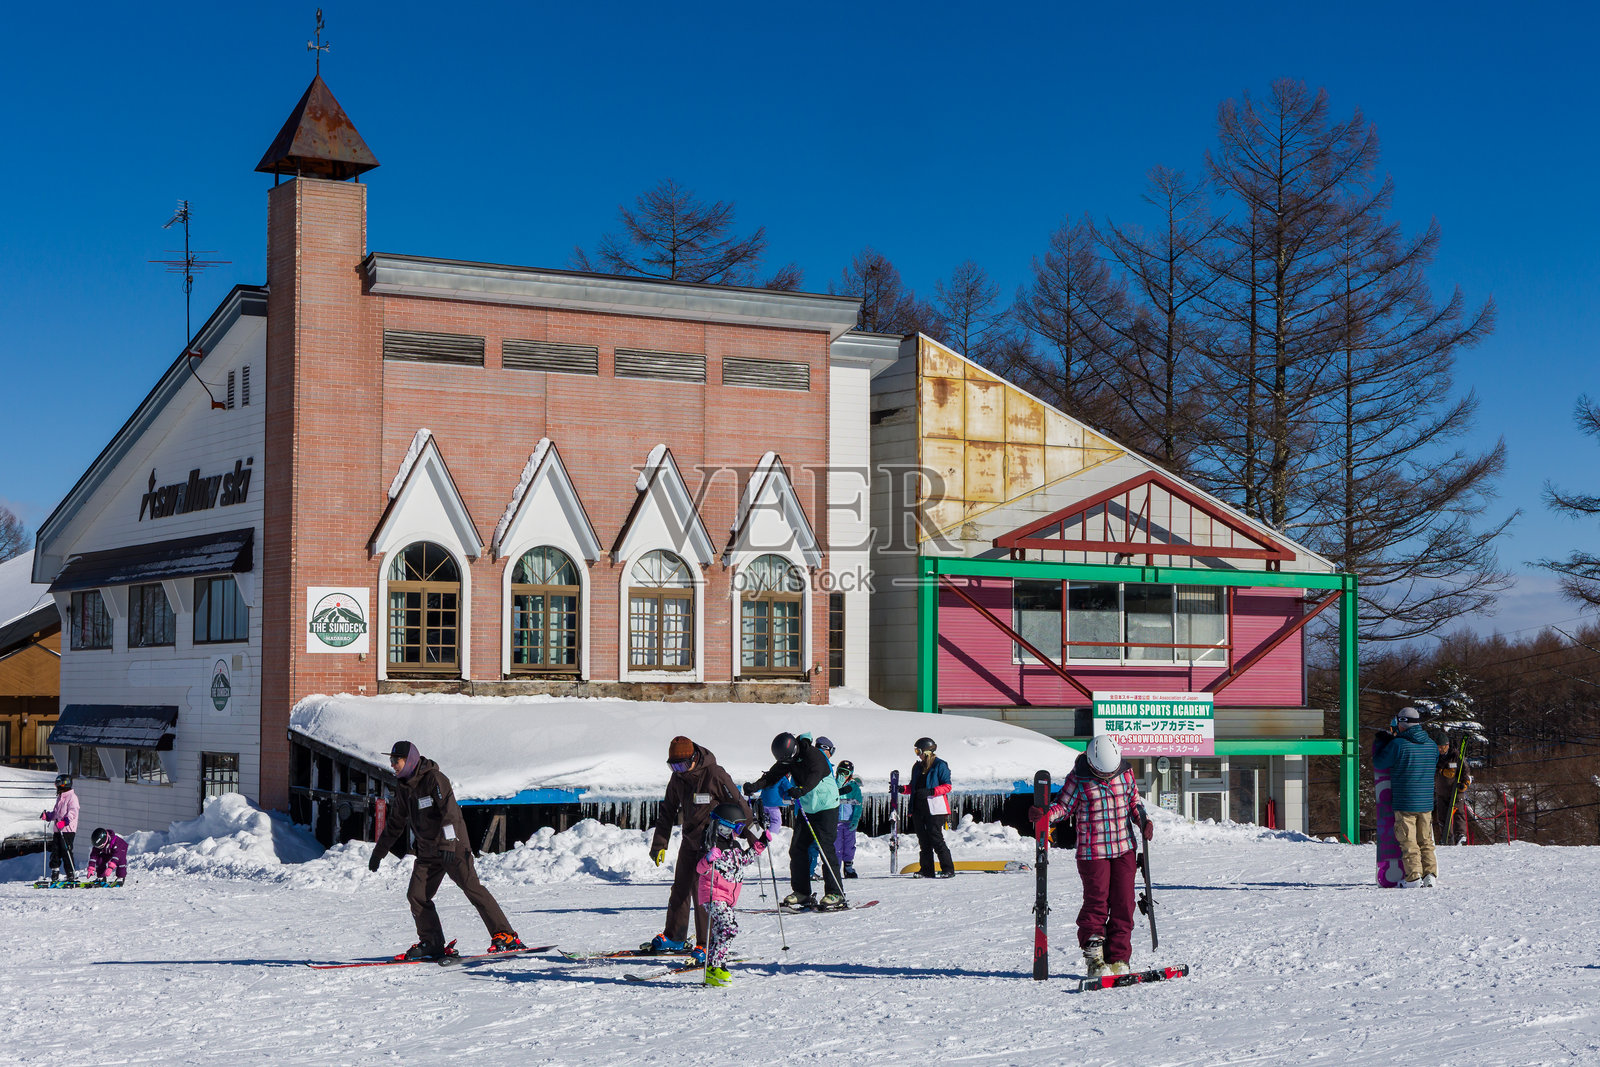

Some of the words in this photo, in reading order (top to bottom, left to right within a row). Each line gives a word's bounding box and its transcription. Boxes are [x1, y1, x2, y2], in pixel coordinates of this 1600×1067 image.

[220, 457, 253, 506] ski
[312, 622, 326, 633] THE
[329, 622, 364, 633] SUNDECK
[1097, 703, 1138, 716] MADARAO
[1139, 704, 1171, 716] SPORTS
[1173, 705, 1210, 716] ACADEMY
[1105, 720, 1204, 731] 斑尾スポーツアカデミー
[1120, 735, 1128, 744] &
[1128, 734, 1174, 744] SNOWBOARD
[1175, 734, 1204, 745] SCHOOL
[1176, 745, 1200, 753] スクール
